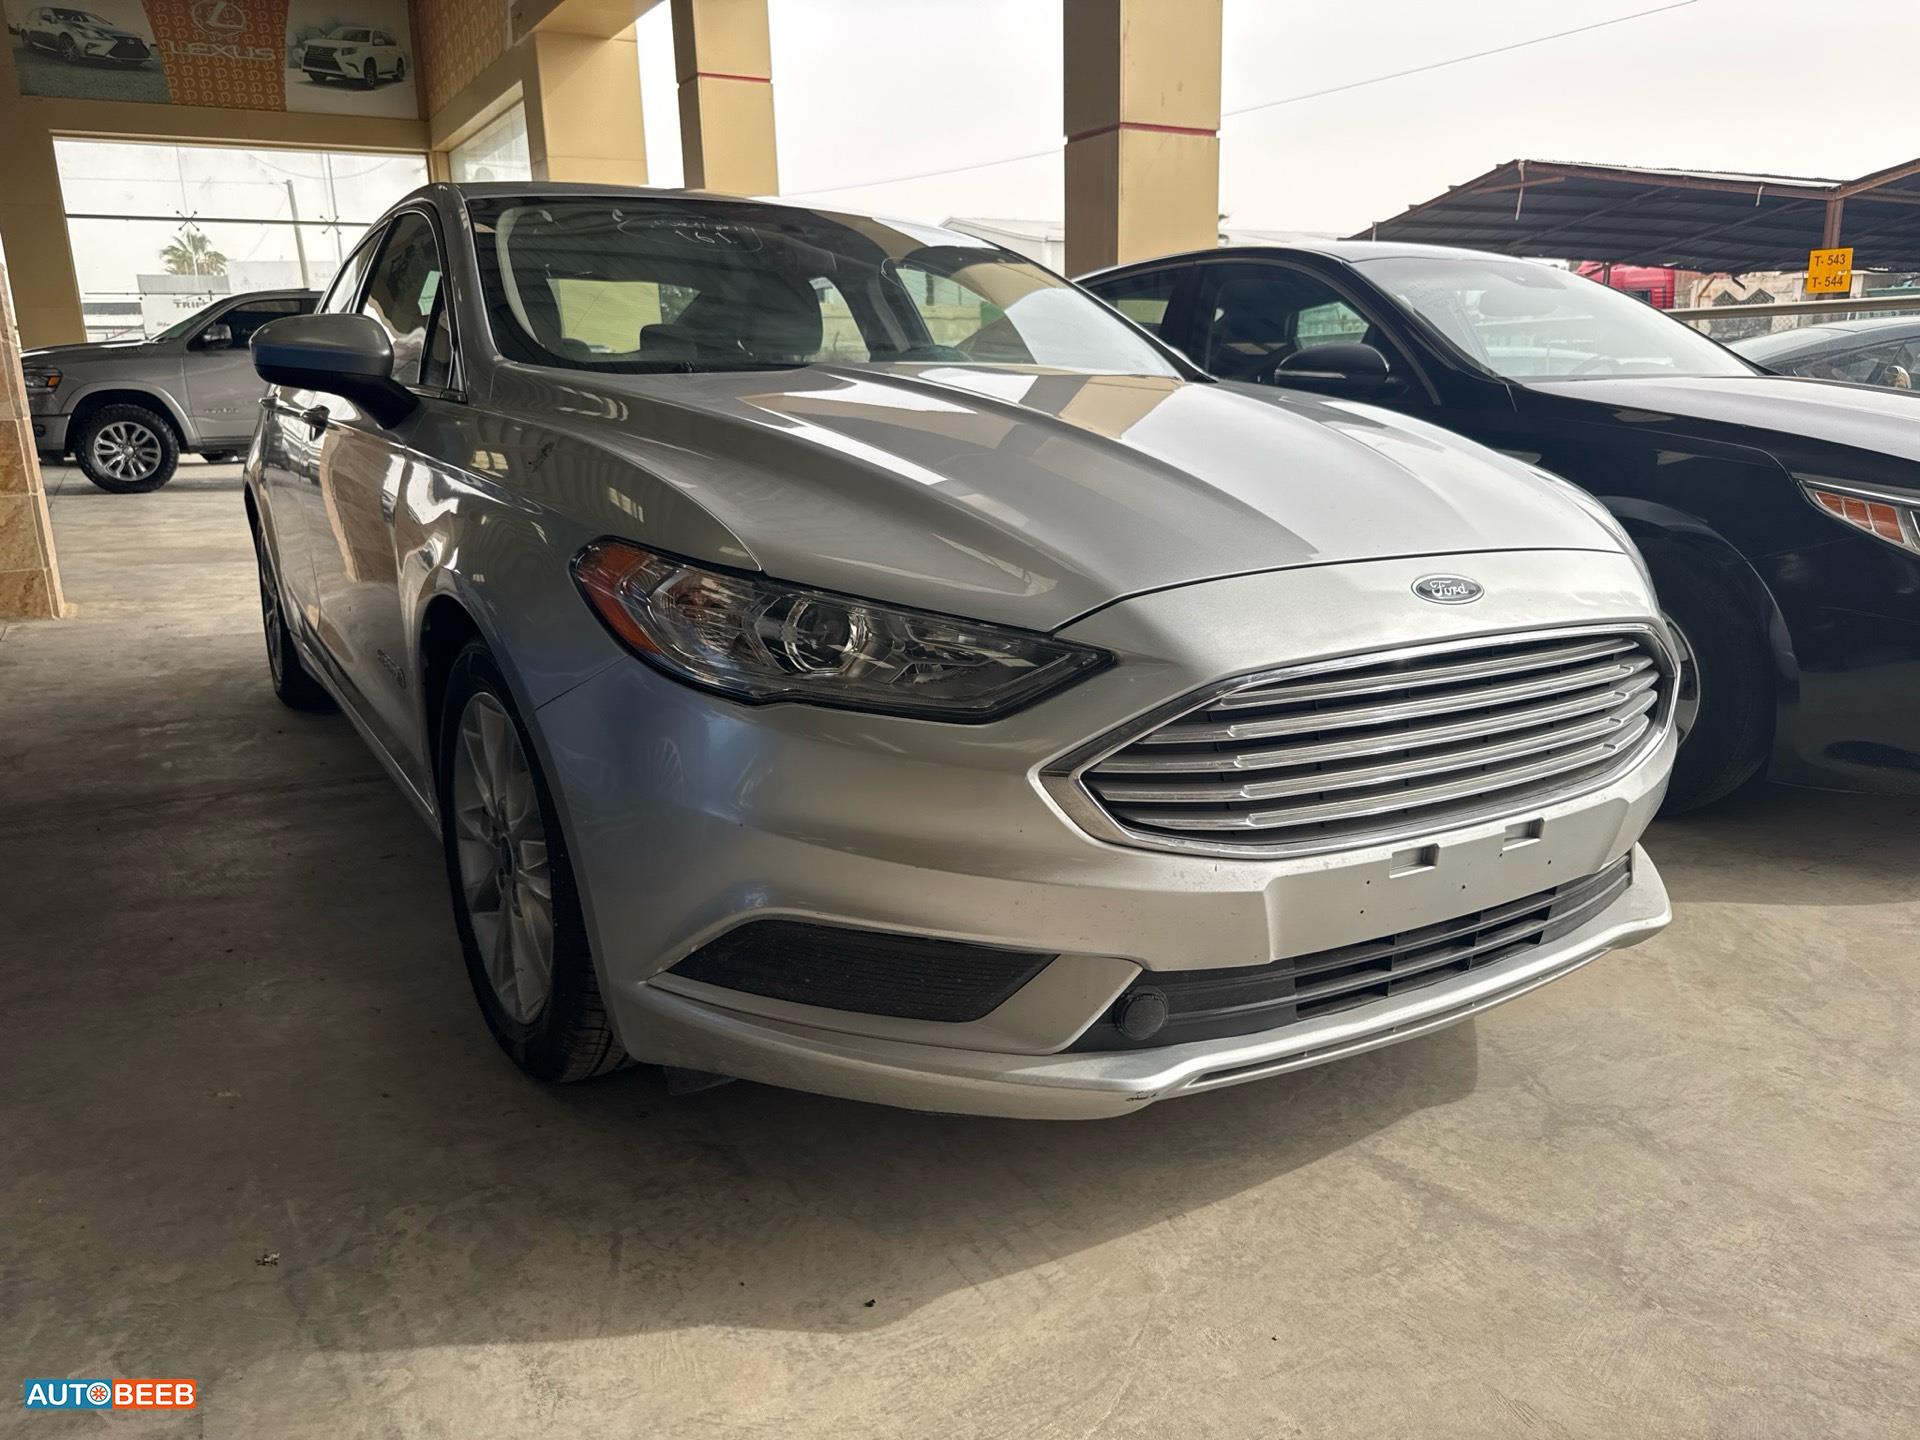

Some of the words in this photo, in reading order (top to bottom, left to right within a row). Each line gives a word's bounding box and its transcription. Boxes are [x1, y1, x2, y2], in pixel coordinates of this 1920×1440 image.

[169, 41, 276, 61] LEXUS
[1827, 254, 1846, 266] 543
[1824, 276, 1844, 287] 544
[1429, 580, 1469, 599] Ford
